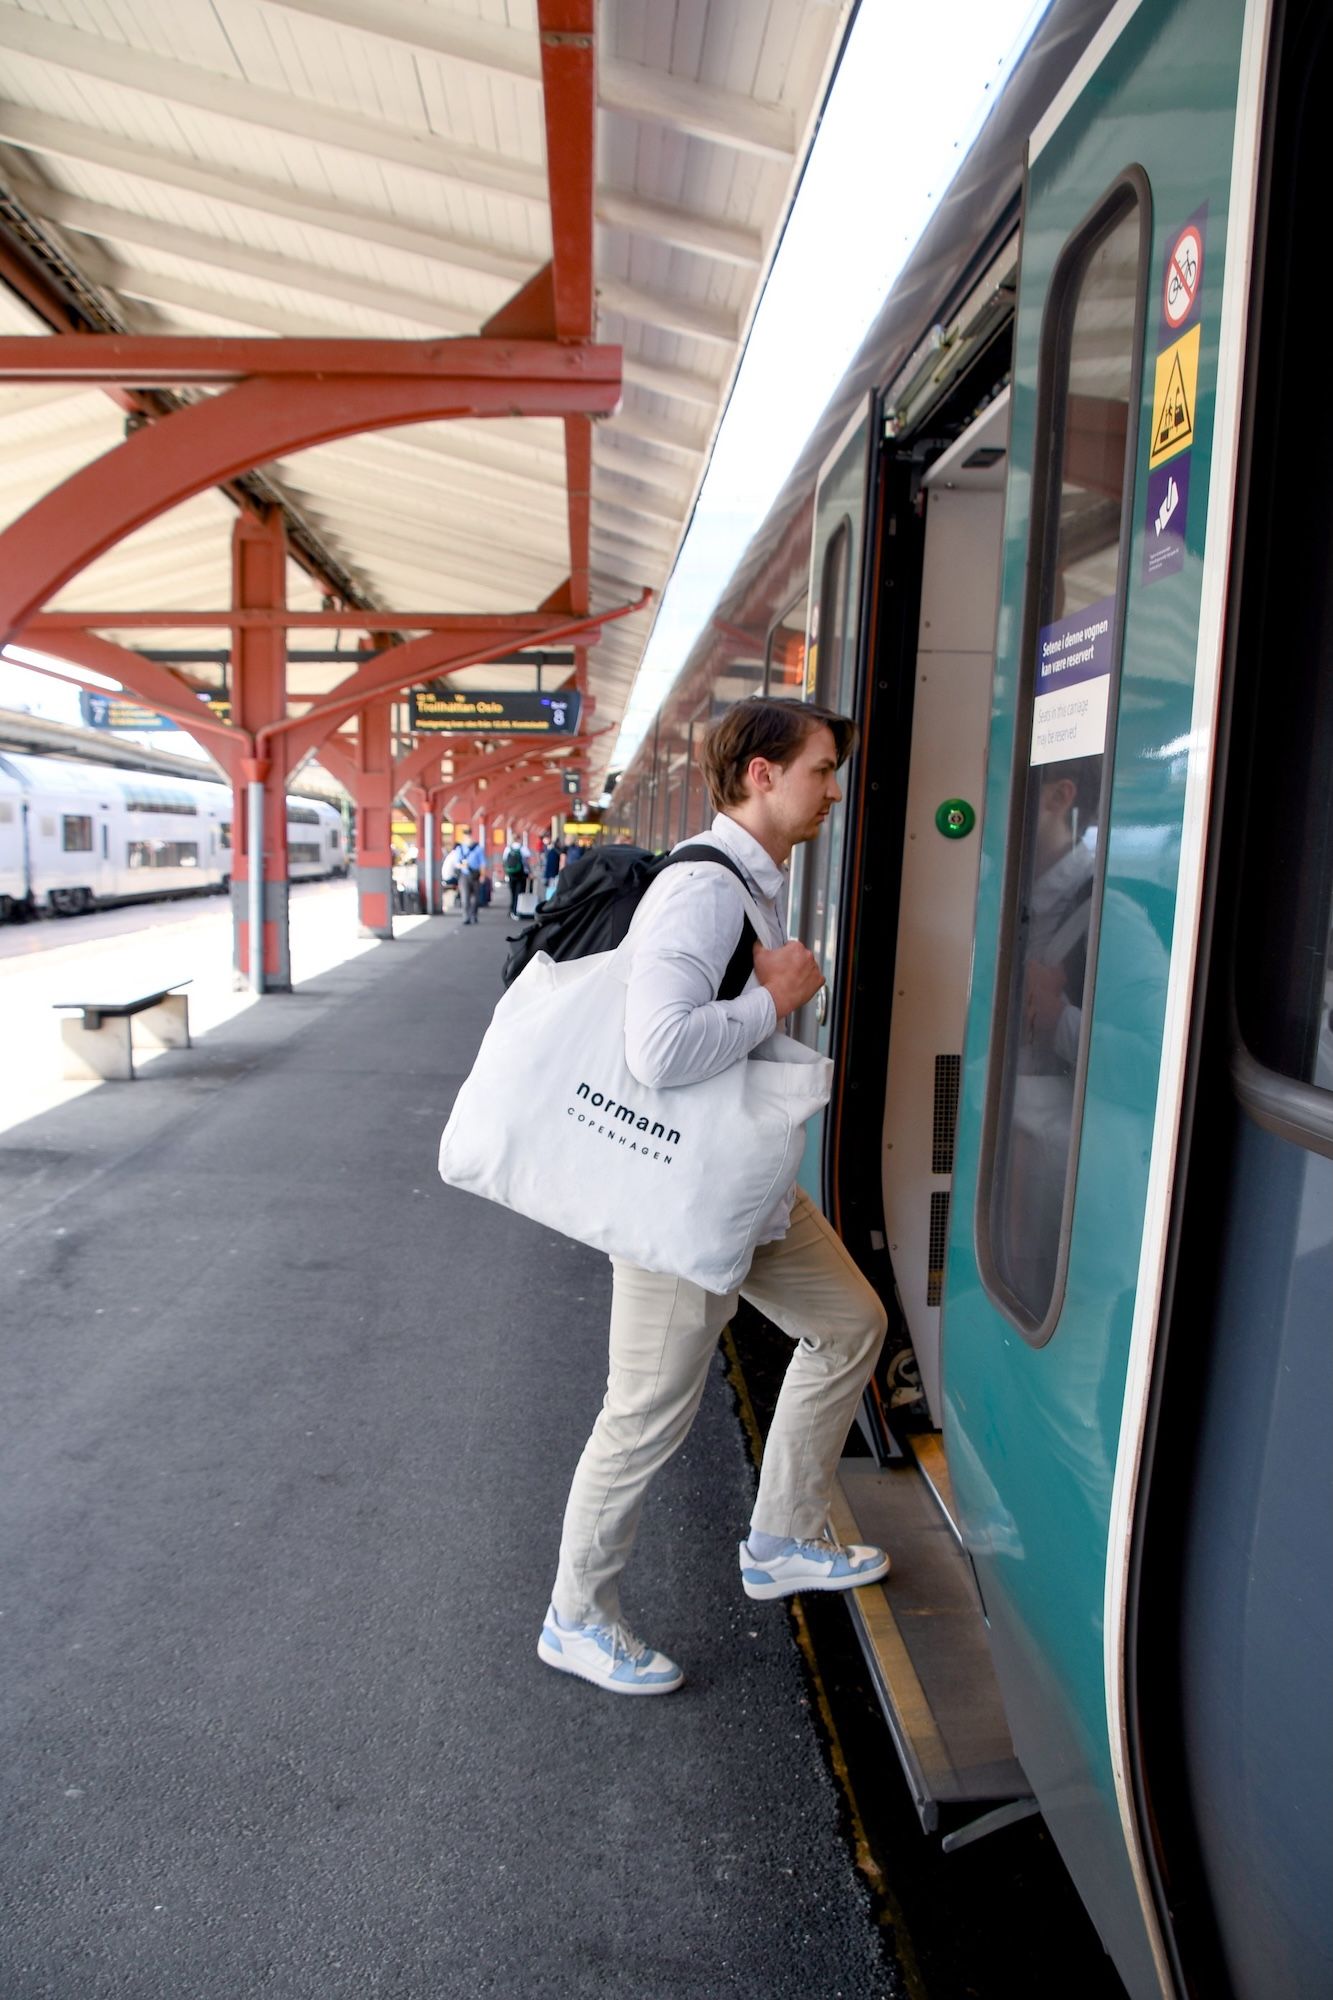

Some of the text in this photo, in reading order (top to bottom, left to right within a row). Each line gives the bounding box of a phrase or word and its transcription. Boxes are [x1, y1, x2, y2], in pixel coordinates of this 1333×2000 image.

[1042, 620, 1108, 657] Setene i denne vognen
[1041, 644, 1094, 677] kan være reservert
[553, 709, 565, 726] 8
[576, 1082, 681, 1144] normann
[567, 1107, 672, 1164] COPENHAGEN
